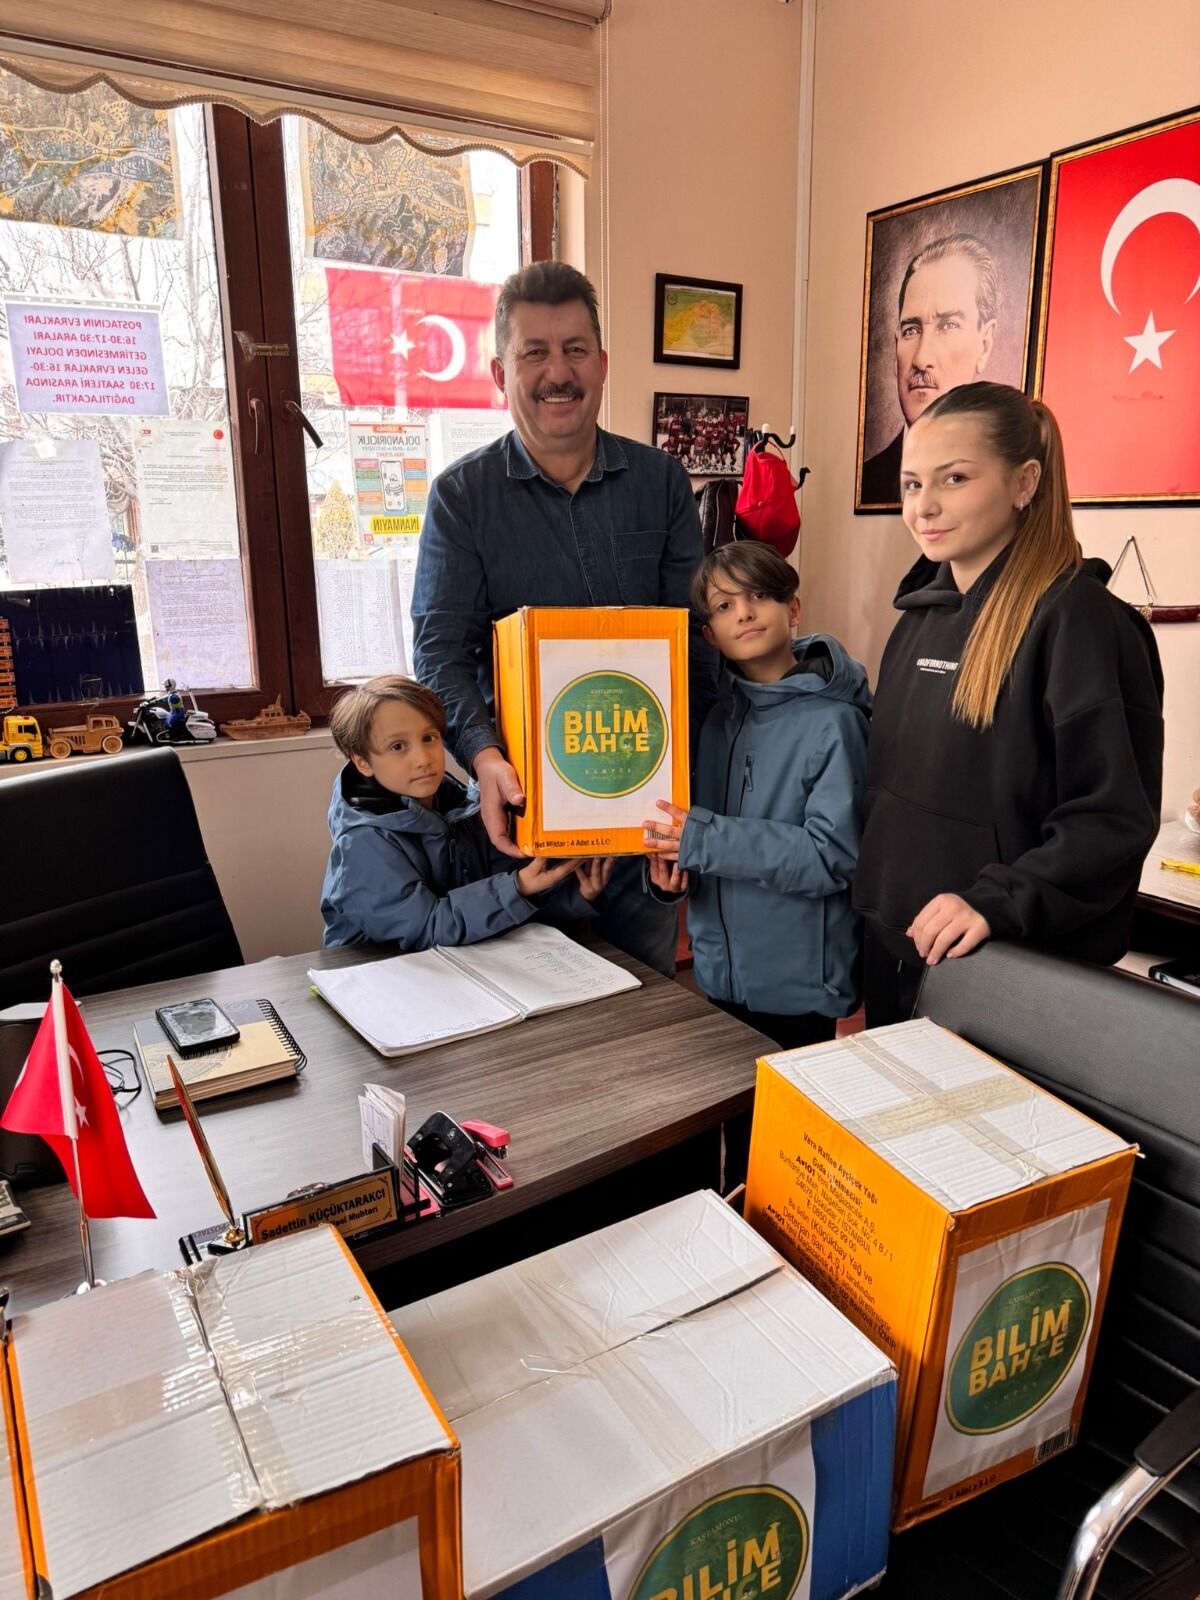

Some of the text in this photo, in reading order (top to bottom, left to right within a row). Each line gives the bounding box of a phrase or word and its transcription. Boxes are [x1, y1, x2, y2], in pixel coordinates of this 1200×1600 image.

[565, 733, 650, 758] BAHÇE
[802, 1131, 817, 1151] Vera
[261, 1188, 386, 1240] Sadettin KÜÇÜKTARAKCI
[348, 1206, 378, 1221] Muhtarı
[848, 1253, 862, 1279] Yağ
[862, 1269, 873, 1288] ve
